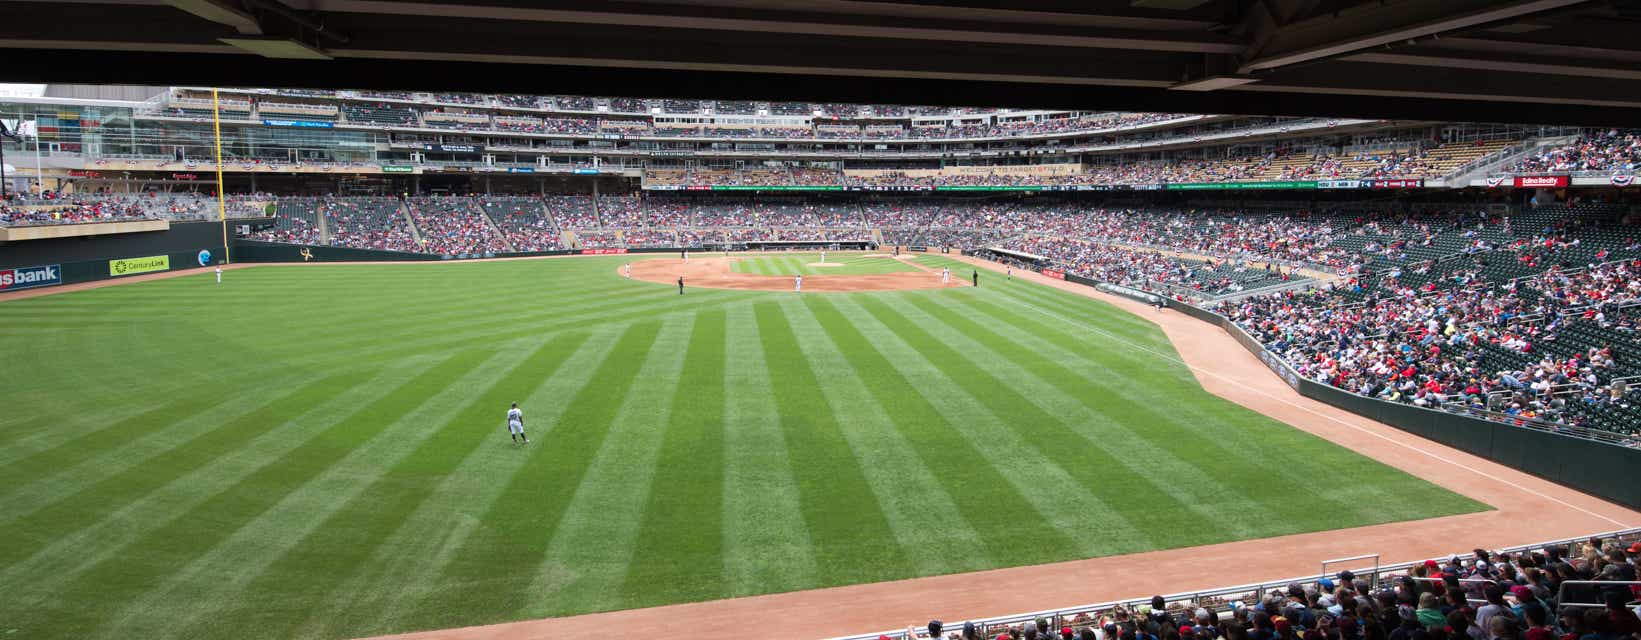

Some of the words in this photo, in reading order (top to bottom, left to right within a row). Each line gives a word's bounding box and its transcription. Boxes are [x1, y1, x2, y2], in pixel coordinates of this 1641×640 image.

[1522, 177, 1537, 186] Edina
[1538, 177, 1558, 186] Realty
[128, 260, 164, 269] CenturyLink
